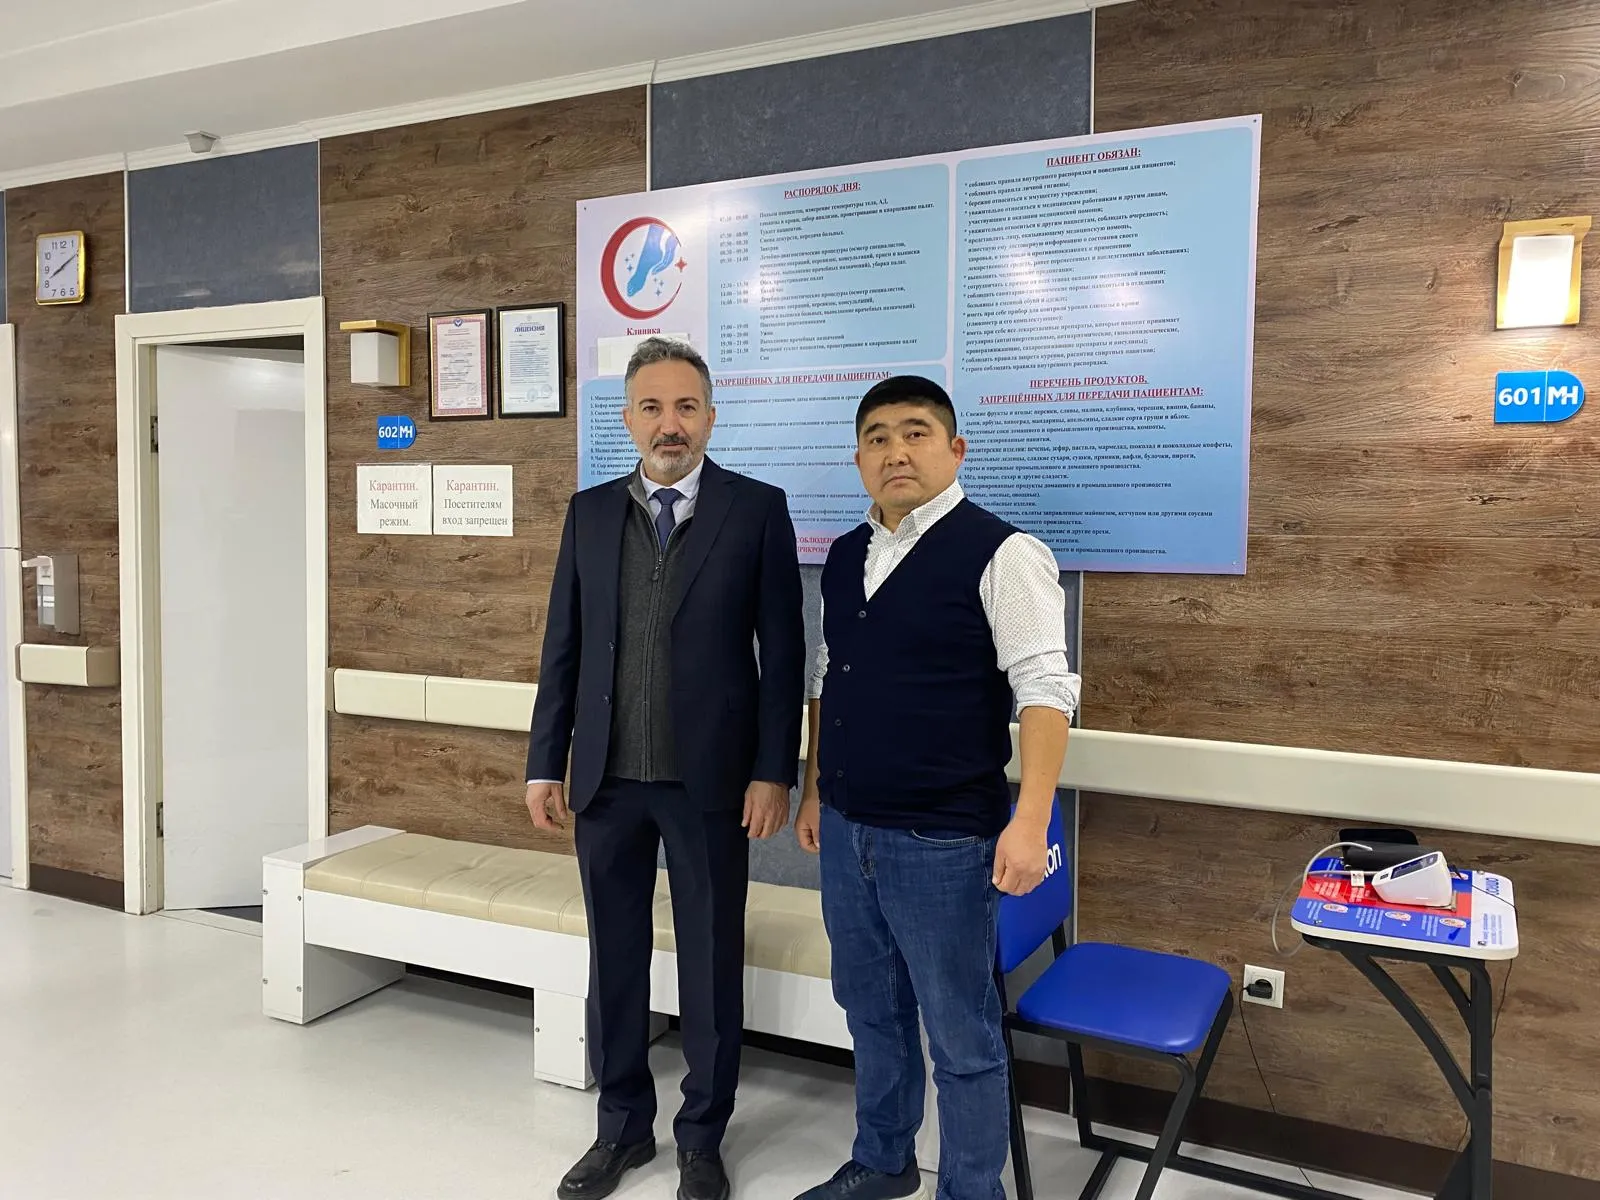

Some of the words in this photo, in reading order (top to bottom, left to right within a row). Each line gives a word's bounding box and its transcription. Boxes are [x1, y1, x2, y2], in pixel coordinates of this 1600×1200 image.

[1046, 153, 1095, 167] ПАЦИЕНТ
[1098, 148, 1141, 161] ОБЯЗАН:
[784, 184, 840, 199] РАСПОРЯДОК
[841, 182, 860, 193] ДНЯ:
[44, 252, 51, 260] 10
[44, 266, 49, 274] 9
[44, 280, 50, 288] 8
[69, 288, 74, 296] 5
[775, 376, 791, 385] ДЛЯ
[792, 374, 834, 385] ПЕРЕДАЧИ
[1030, 379, 1080, 389] ПЕРЕЧЕНЬ
[980, 393, 1052, 405] ЗАПРЕЩЁННЫХ
[1055, 392, 1075, 402] ДЛЯ
[1078, 390, 1130, 401] ПЕРЕДАЧИ
[1133, 387, 1204, 399] ПАЦИЕНТАМ:
[1499, 386, 1540, 406] 601
[378, 427, 397, 438] 602
[369, 480, 418, 494] Карантин.
[446, 480, 499, 494] Карантин.
[370, 499, 418, 510] Масочный
[444, 498, 502, 509] Посетителям
[379, 518, 411, 528] режим.
[442, 516, 462, 526] вход
[466, 517, 508, 528] запрещен
